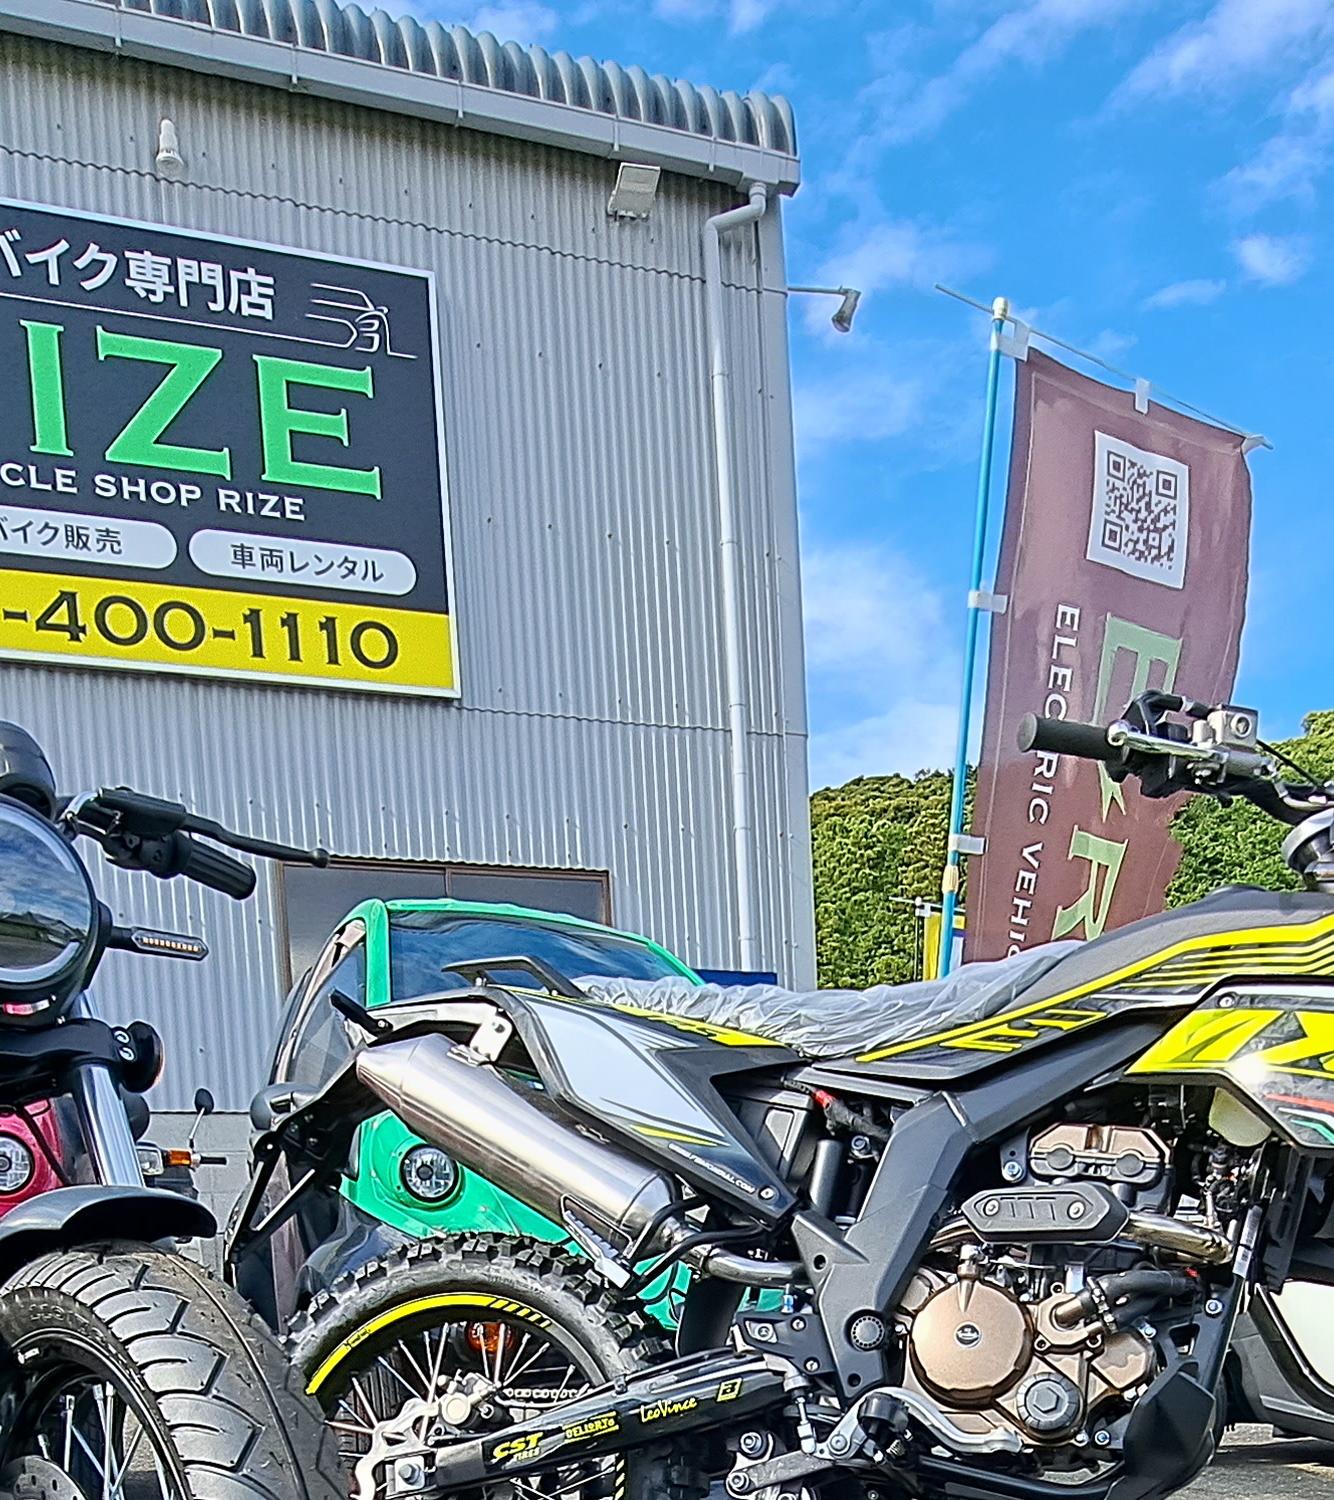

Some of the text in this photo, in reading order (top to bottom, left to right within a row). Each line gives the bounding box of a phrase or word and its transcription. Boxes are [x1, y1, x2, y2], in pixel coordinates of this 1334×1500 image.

[93, 473, 202, 509] SHOP
[217, 490, 306, 522] RIZE
[230, 543, 385, 584] 車両レンタル
[1025, 603, 1080, 827] ELECRIC
[493, 1432, 543, 1460] CST
